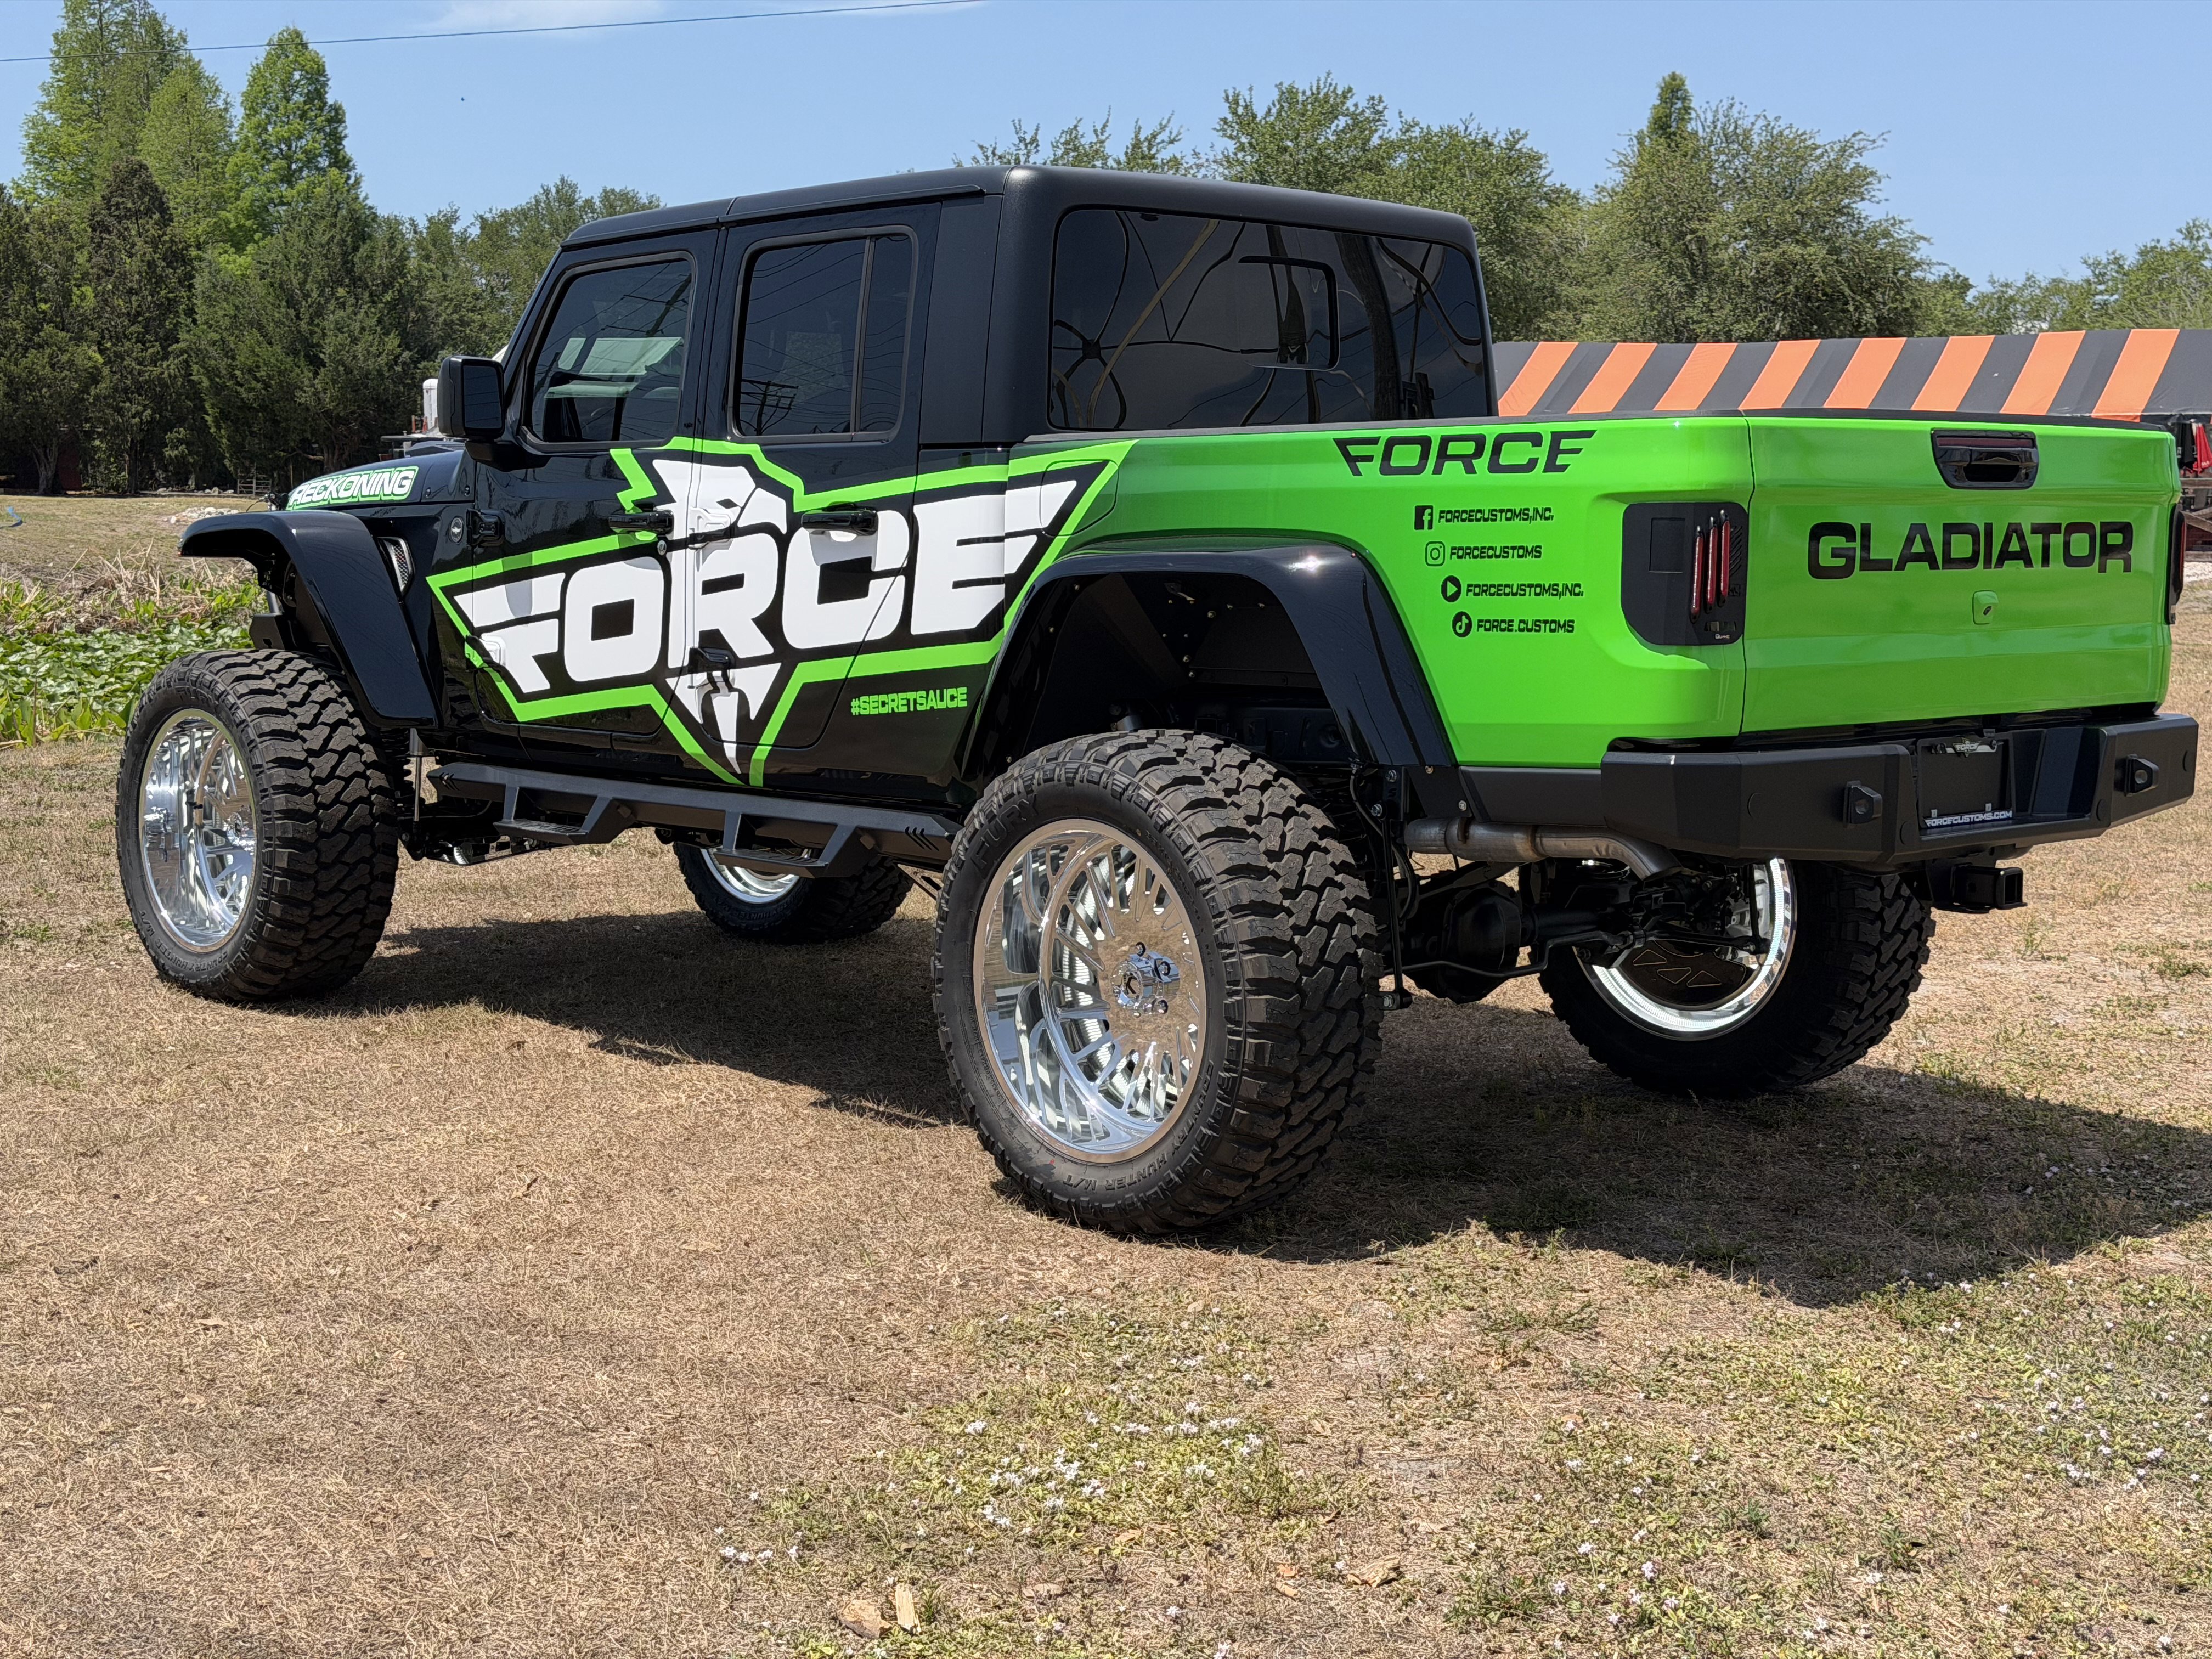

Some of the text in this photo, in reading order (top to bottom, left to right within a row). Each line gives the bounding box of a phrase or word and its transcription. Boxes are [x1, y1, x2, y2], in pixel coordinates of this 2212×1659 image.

[1332, 430, 1598, 476] FORCE
[289, 470, 417, 506] RECKONING
[1438, 507, 1554, 524] FORCECUSTOMS,INC.
[1449, 545, 1542, 560] FORCECUSTOMS
[1808, 521, 2134, 580] GLADIATOR
[454, 480, 1077, 693] FORCE
[1465, 583, 1584, 600] FORCECUSTOMS,INC.
[1476, 618, 1575, 633] FORCE.CUSTOMS
[850, 687, 968, 715] #SECRETSAUCE
[970, 792, 1039, 868] FURY
[1925, 810, 2013, 827] FORCECUSTOMS.COM
[1062, 1174, 1097, 1192] M/T
[1105, 1152, 1168, 1192] HUNTER
